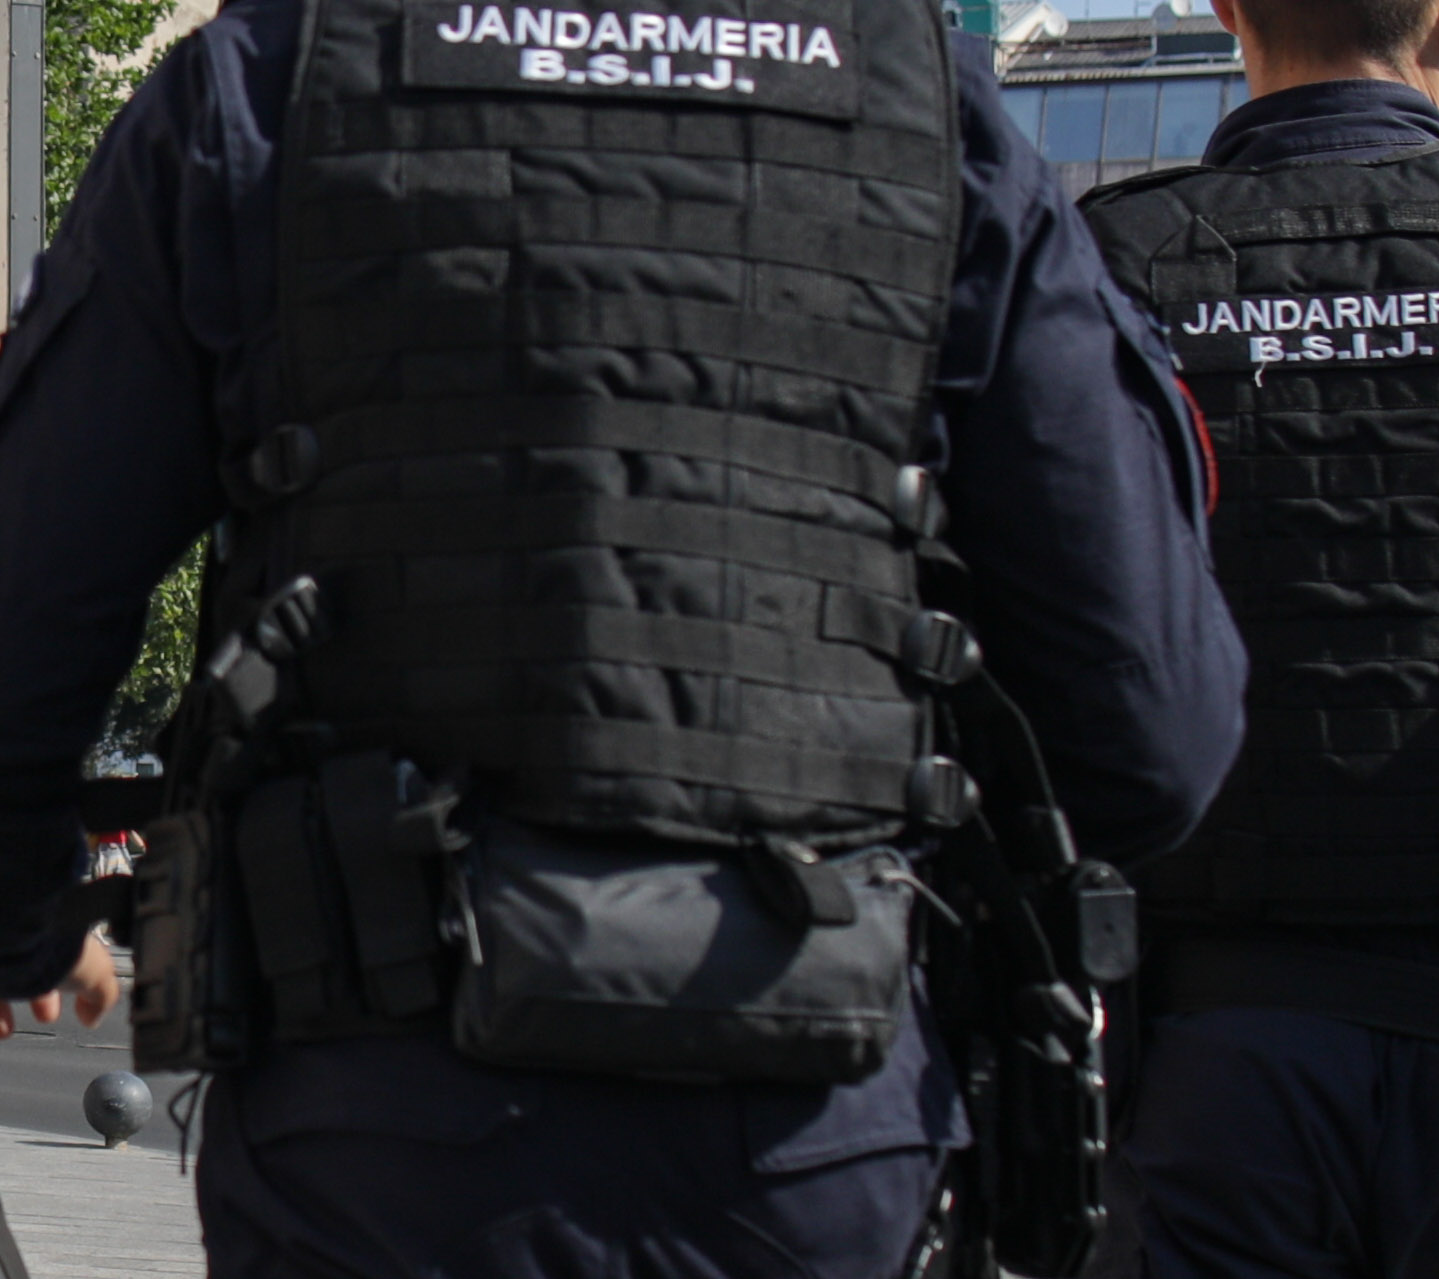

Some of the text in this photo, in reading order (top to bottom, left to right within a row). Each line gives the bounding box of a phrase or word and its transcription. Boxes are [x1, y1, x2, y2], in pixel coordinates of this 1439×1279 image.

[437, 4, 841, 68] JANDARMERIA
[519, 48, 755, 94] B.S.I.J.
[1250, 331, 1434, 363] B.S.I.J.
